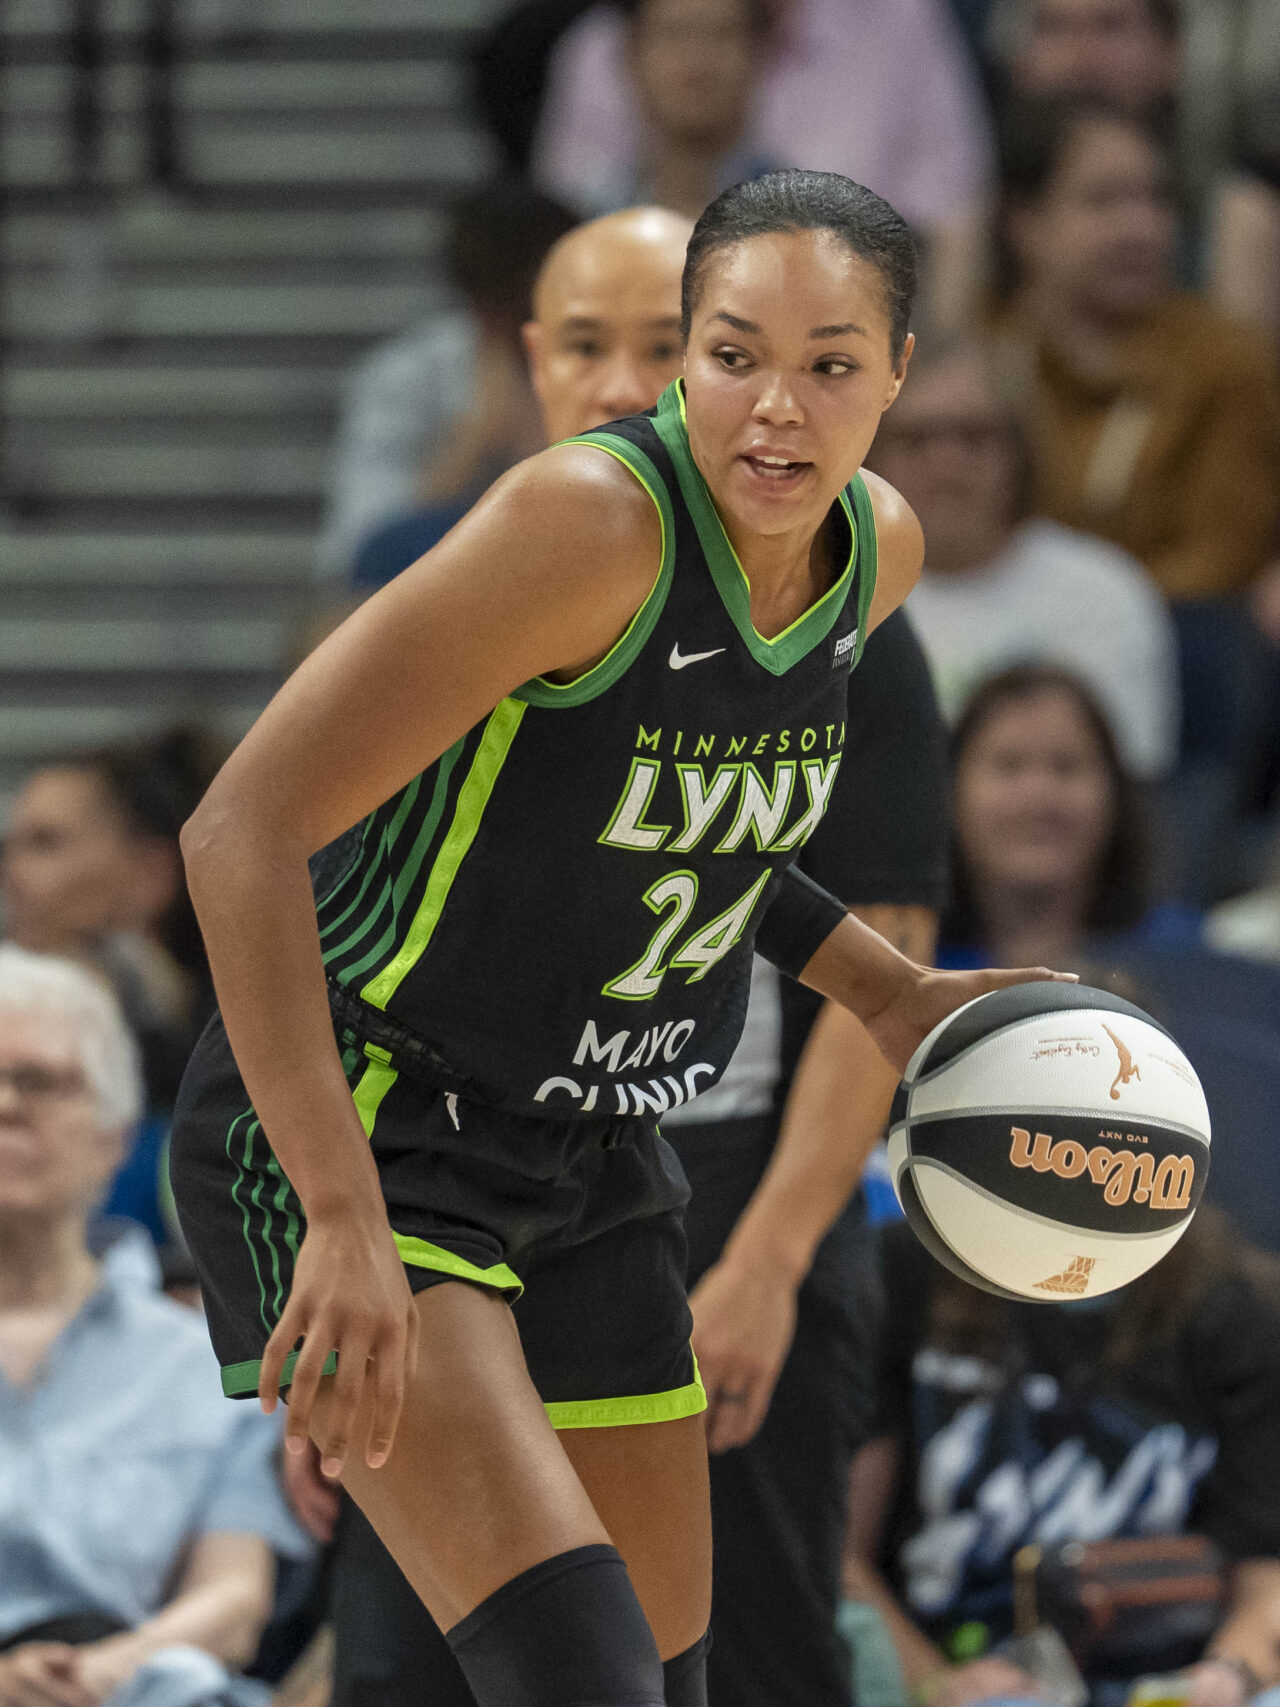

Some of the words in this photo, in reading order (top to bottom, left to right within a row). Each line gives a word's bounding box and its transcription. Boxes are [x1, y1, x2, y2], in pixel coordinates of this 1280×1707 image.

[635, 721, 845, 758] MINNESOTA
[597, 751, 842, 854] LYNX
[601, 868, 772, 1000] 24
[572, 1019, 696, 1073] MAYO
[1009, 1126, 1196, 1210] Wilson
[1098, 1129, 1123, 1141] NXT
